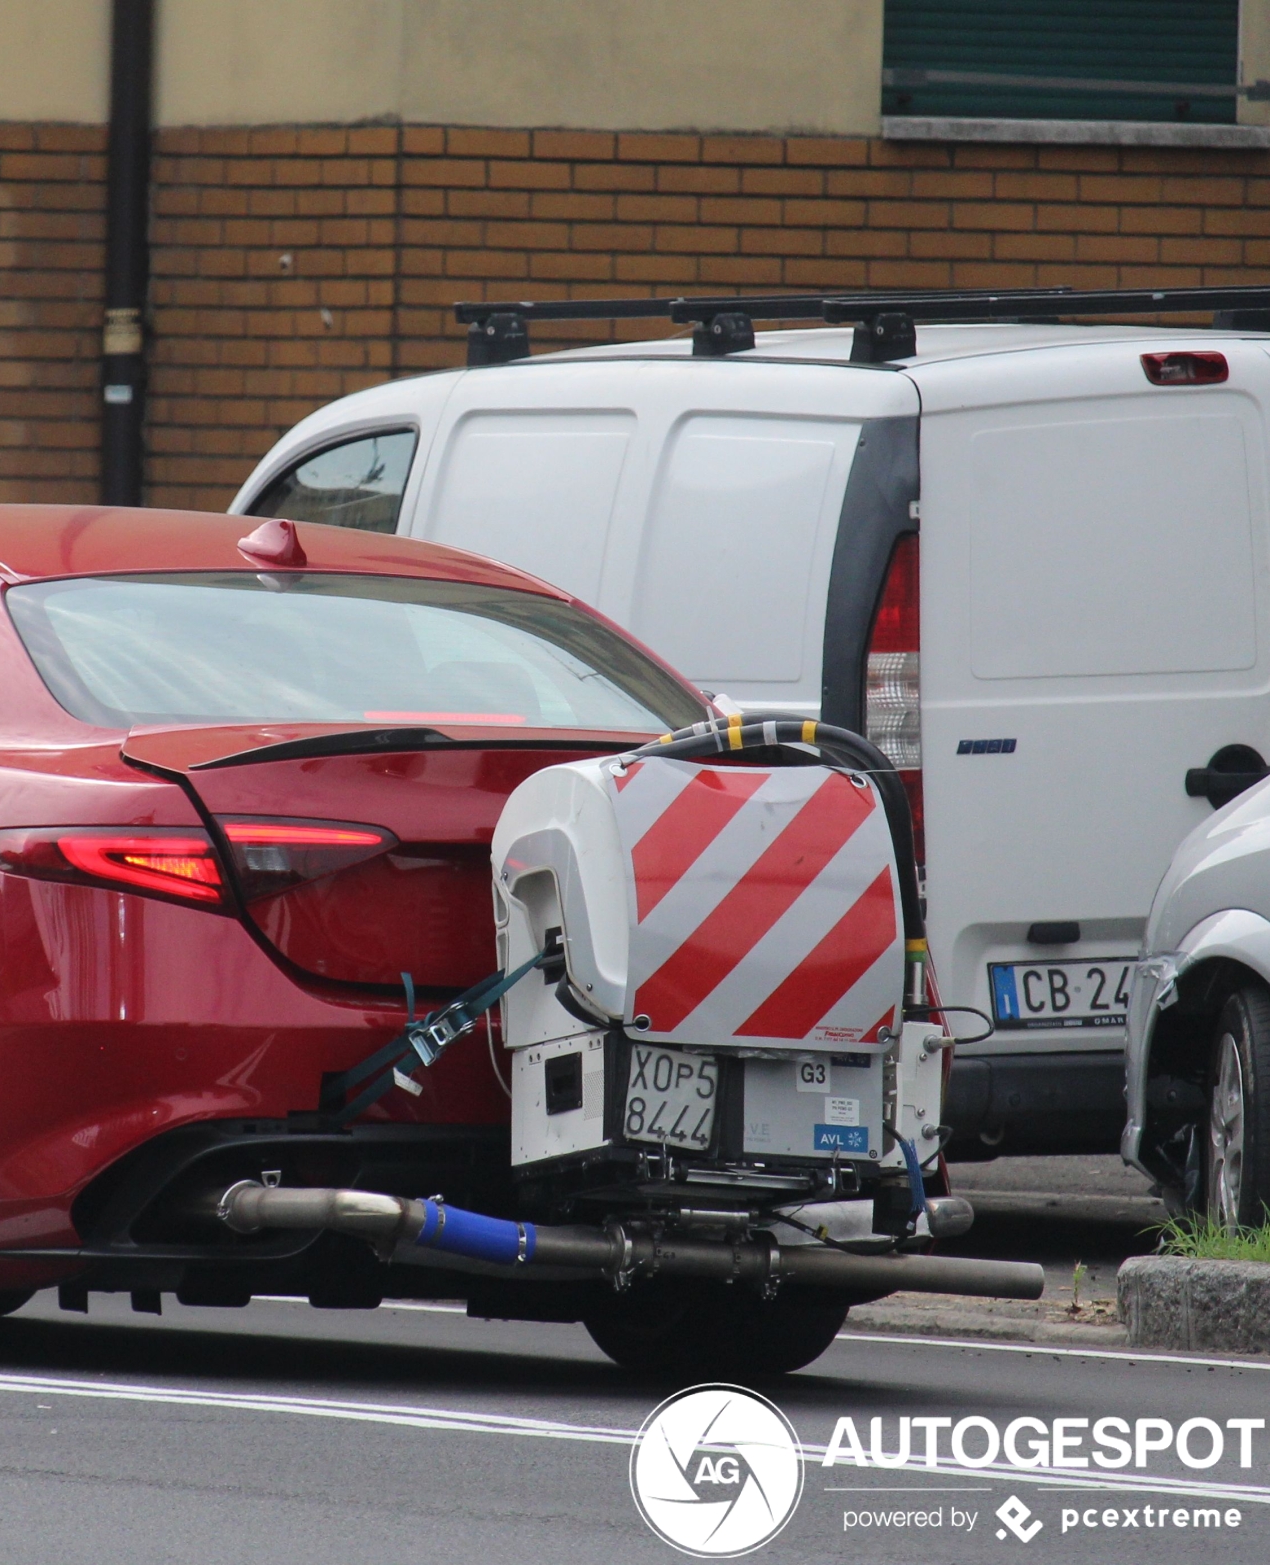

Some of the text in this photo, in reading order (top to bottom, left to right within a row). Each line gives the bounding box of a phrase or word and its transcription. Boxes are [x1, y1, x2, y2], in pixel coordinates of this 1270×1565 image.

[1023, 969, 1070, 1013] CB
[801, 1063, 826, 1084] G3
[626, 1097, 710, 1145] 8444
[820, 1133, 844, 1146] AVL
